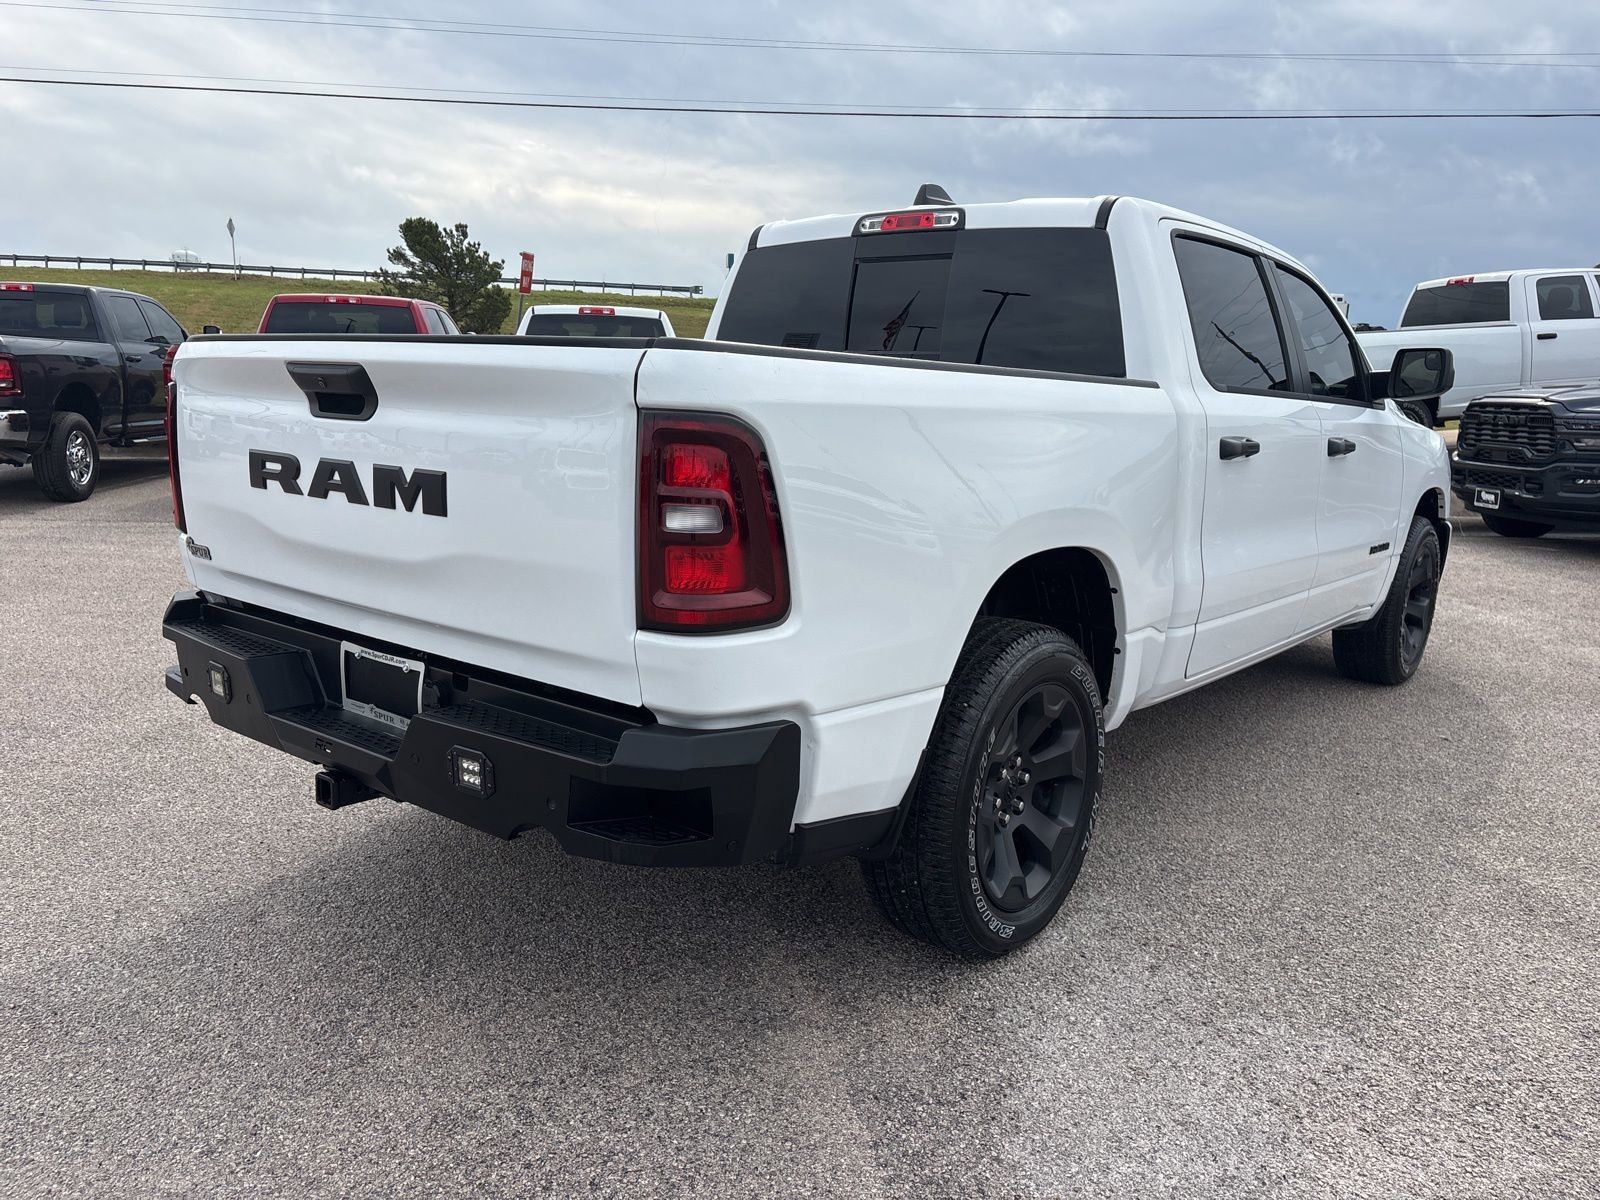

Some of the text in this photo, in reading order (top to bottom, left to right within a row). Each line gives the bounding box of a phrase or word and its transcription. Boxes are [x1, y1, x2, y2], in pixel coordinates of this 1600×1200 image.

[1480, 413, 1526, 425] RAM
[249, 448, 448, 518] RAM
[190, 545, 210, 559] SPUR
[373, 710, 395, 724] SPUR
[967, 726, 1016, 939] BRIDGESTONE
